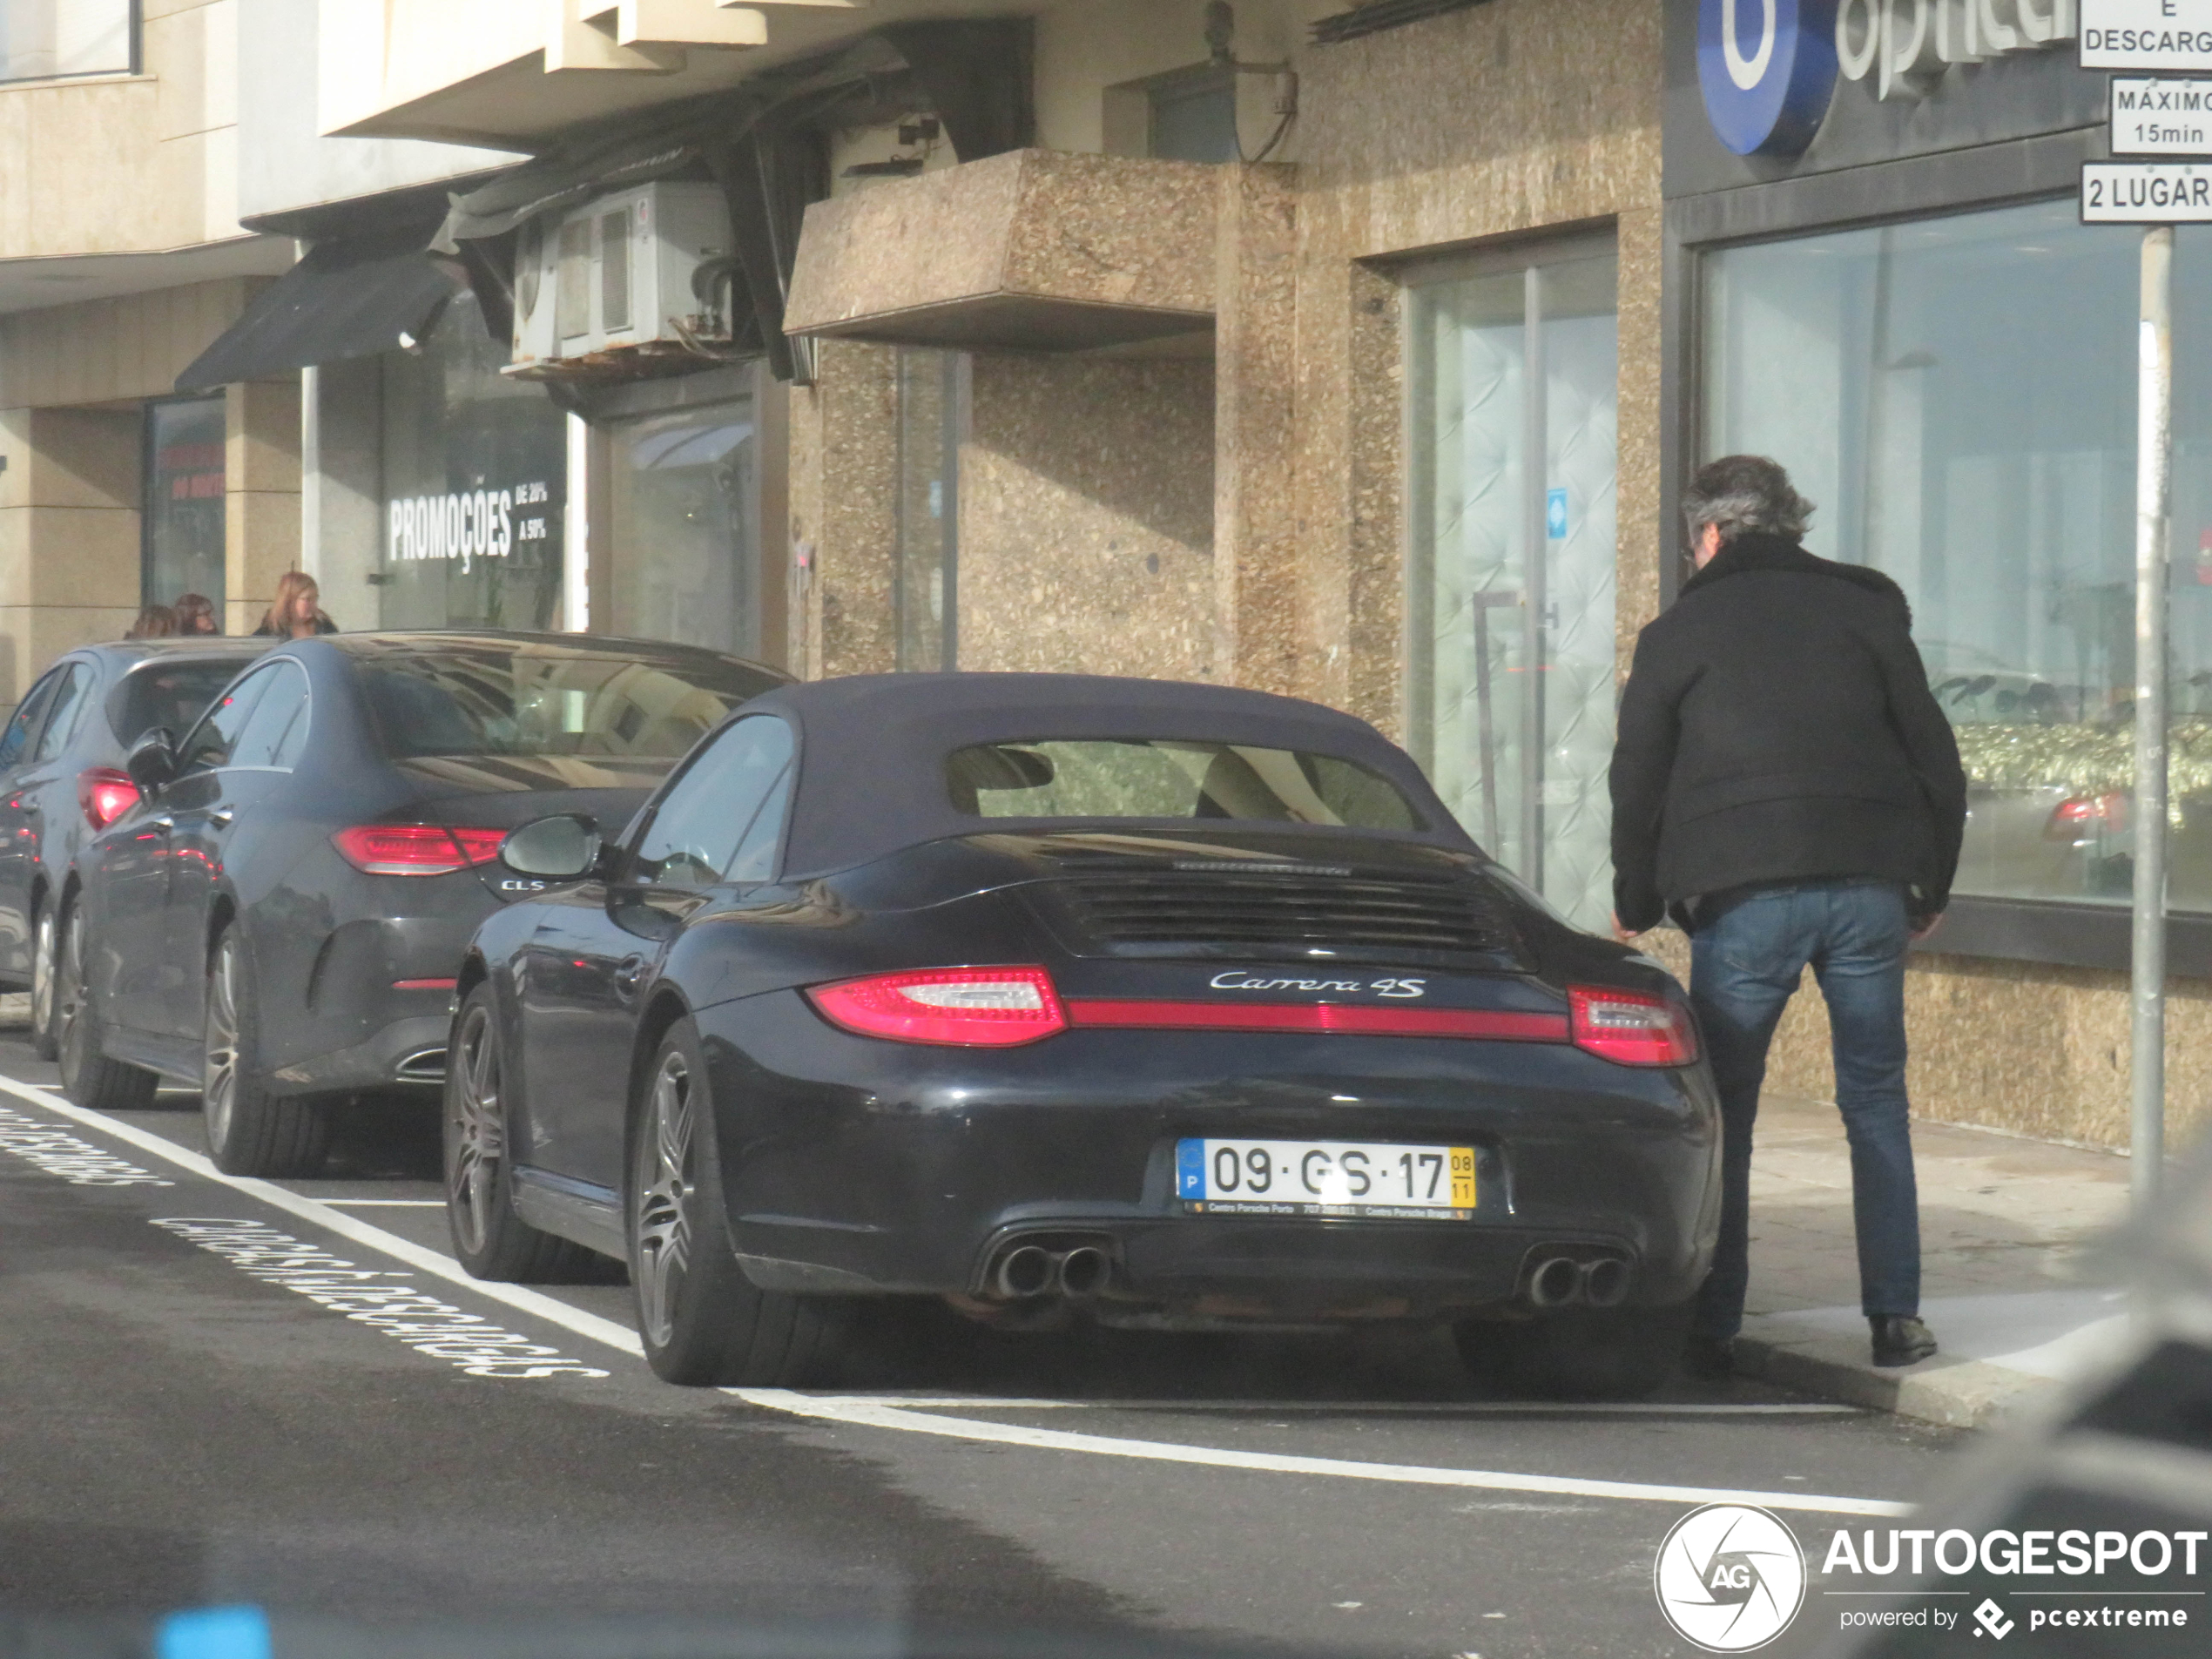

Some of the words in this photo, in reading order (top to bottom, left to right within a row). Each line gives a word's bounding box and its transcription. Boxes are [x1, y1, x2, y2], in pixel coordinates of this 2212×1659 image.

[2161, 0, 2177, 17] E
[2134, 124, 2203, 143] 15min
[2089, 179, 2103, 207] 2
[2113, 178, 2210, 206] LUGAR
[516, 484, 528, 505] DE
[390, 475, 511, 575] PROMOÇÕES
[501, 880, 546, 890] CLS
[1211, 971, 1360, 992] Carrera
[1370, 978, 1426, 998] 4S
[1451, 1156, 1472, 1171] 08
[148, 1217, 355, 1266] CARGAS
[287, 1285, 610, 1378] DESCARGAS
